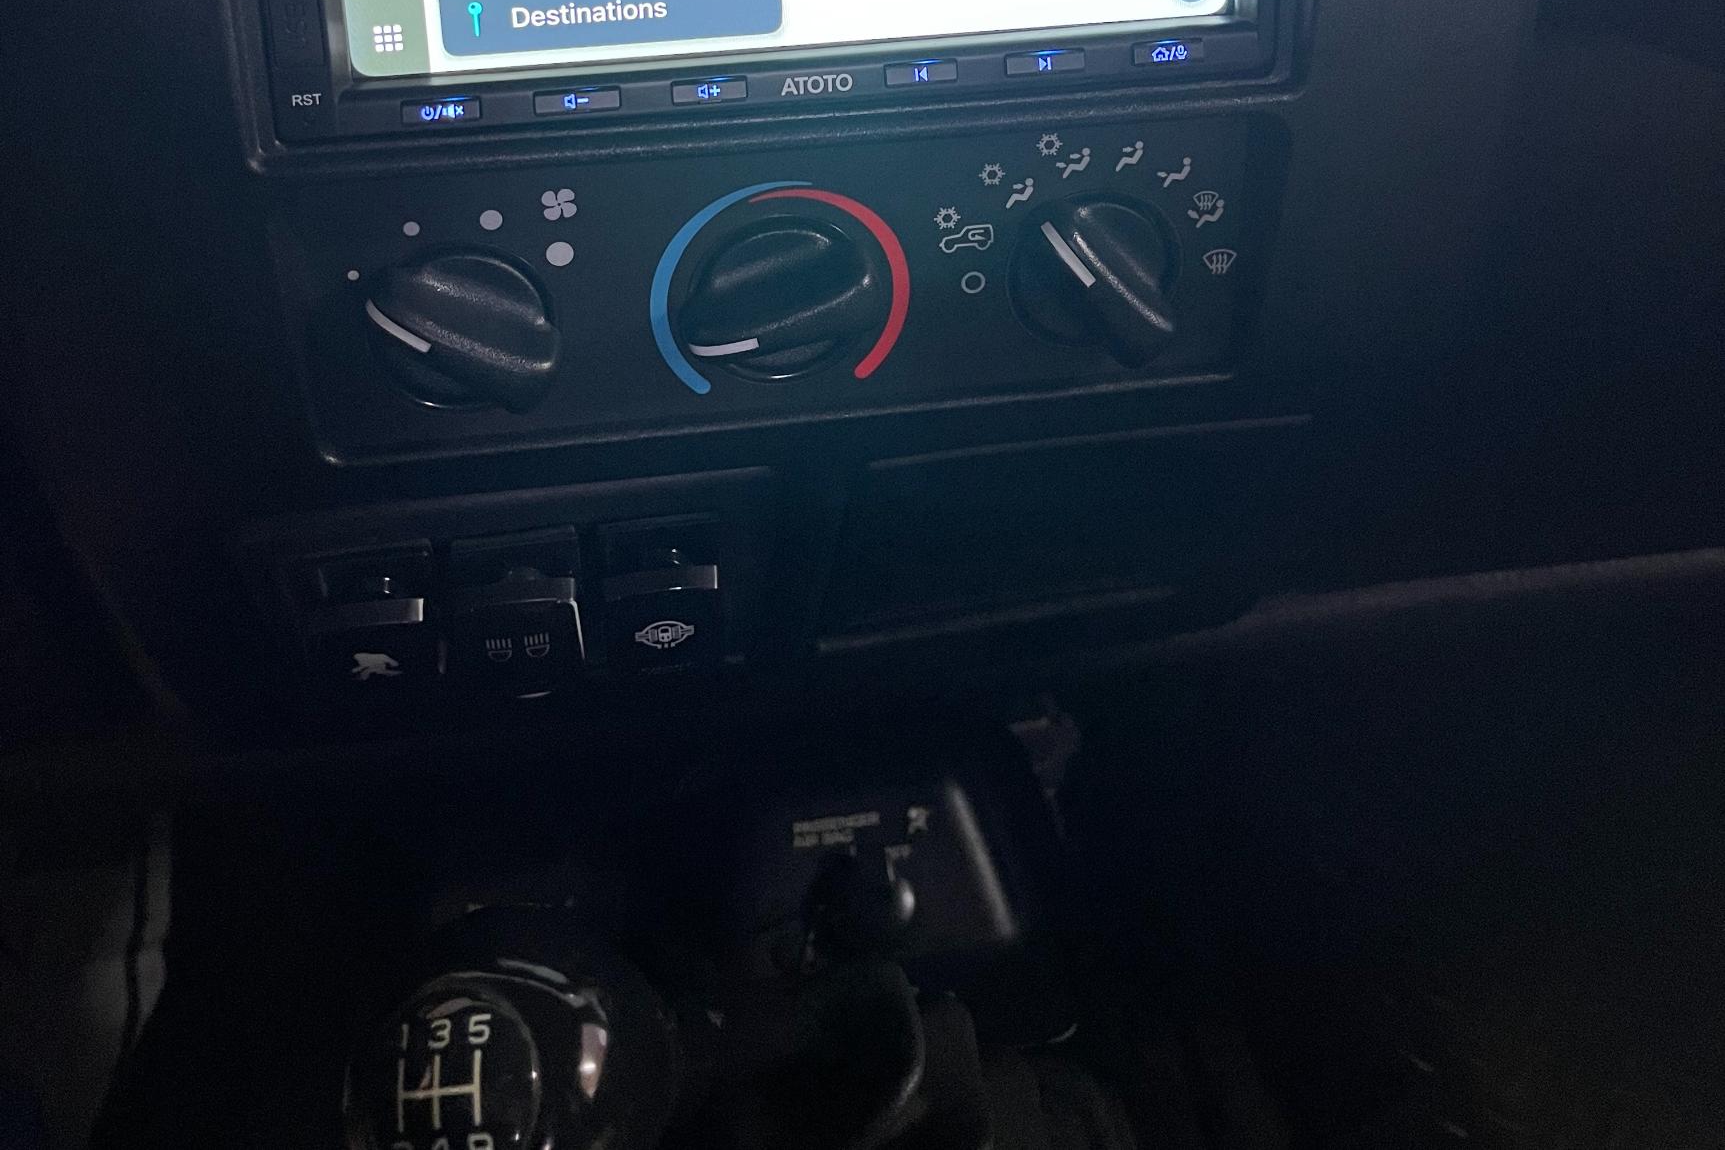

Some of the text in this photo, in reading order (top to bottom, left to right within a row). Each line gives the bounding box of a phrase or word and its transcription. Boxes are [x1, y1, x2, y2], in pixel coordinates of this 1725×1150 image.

[511, 0, 668, 29] Destinations
[781, 73, 853, 96] ATOTO
[291, 93, 322, 107] RST
[428, 1018, 451, 1049] 3
[468, 1013, 491, 1045] 5
